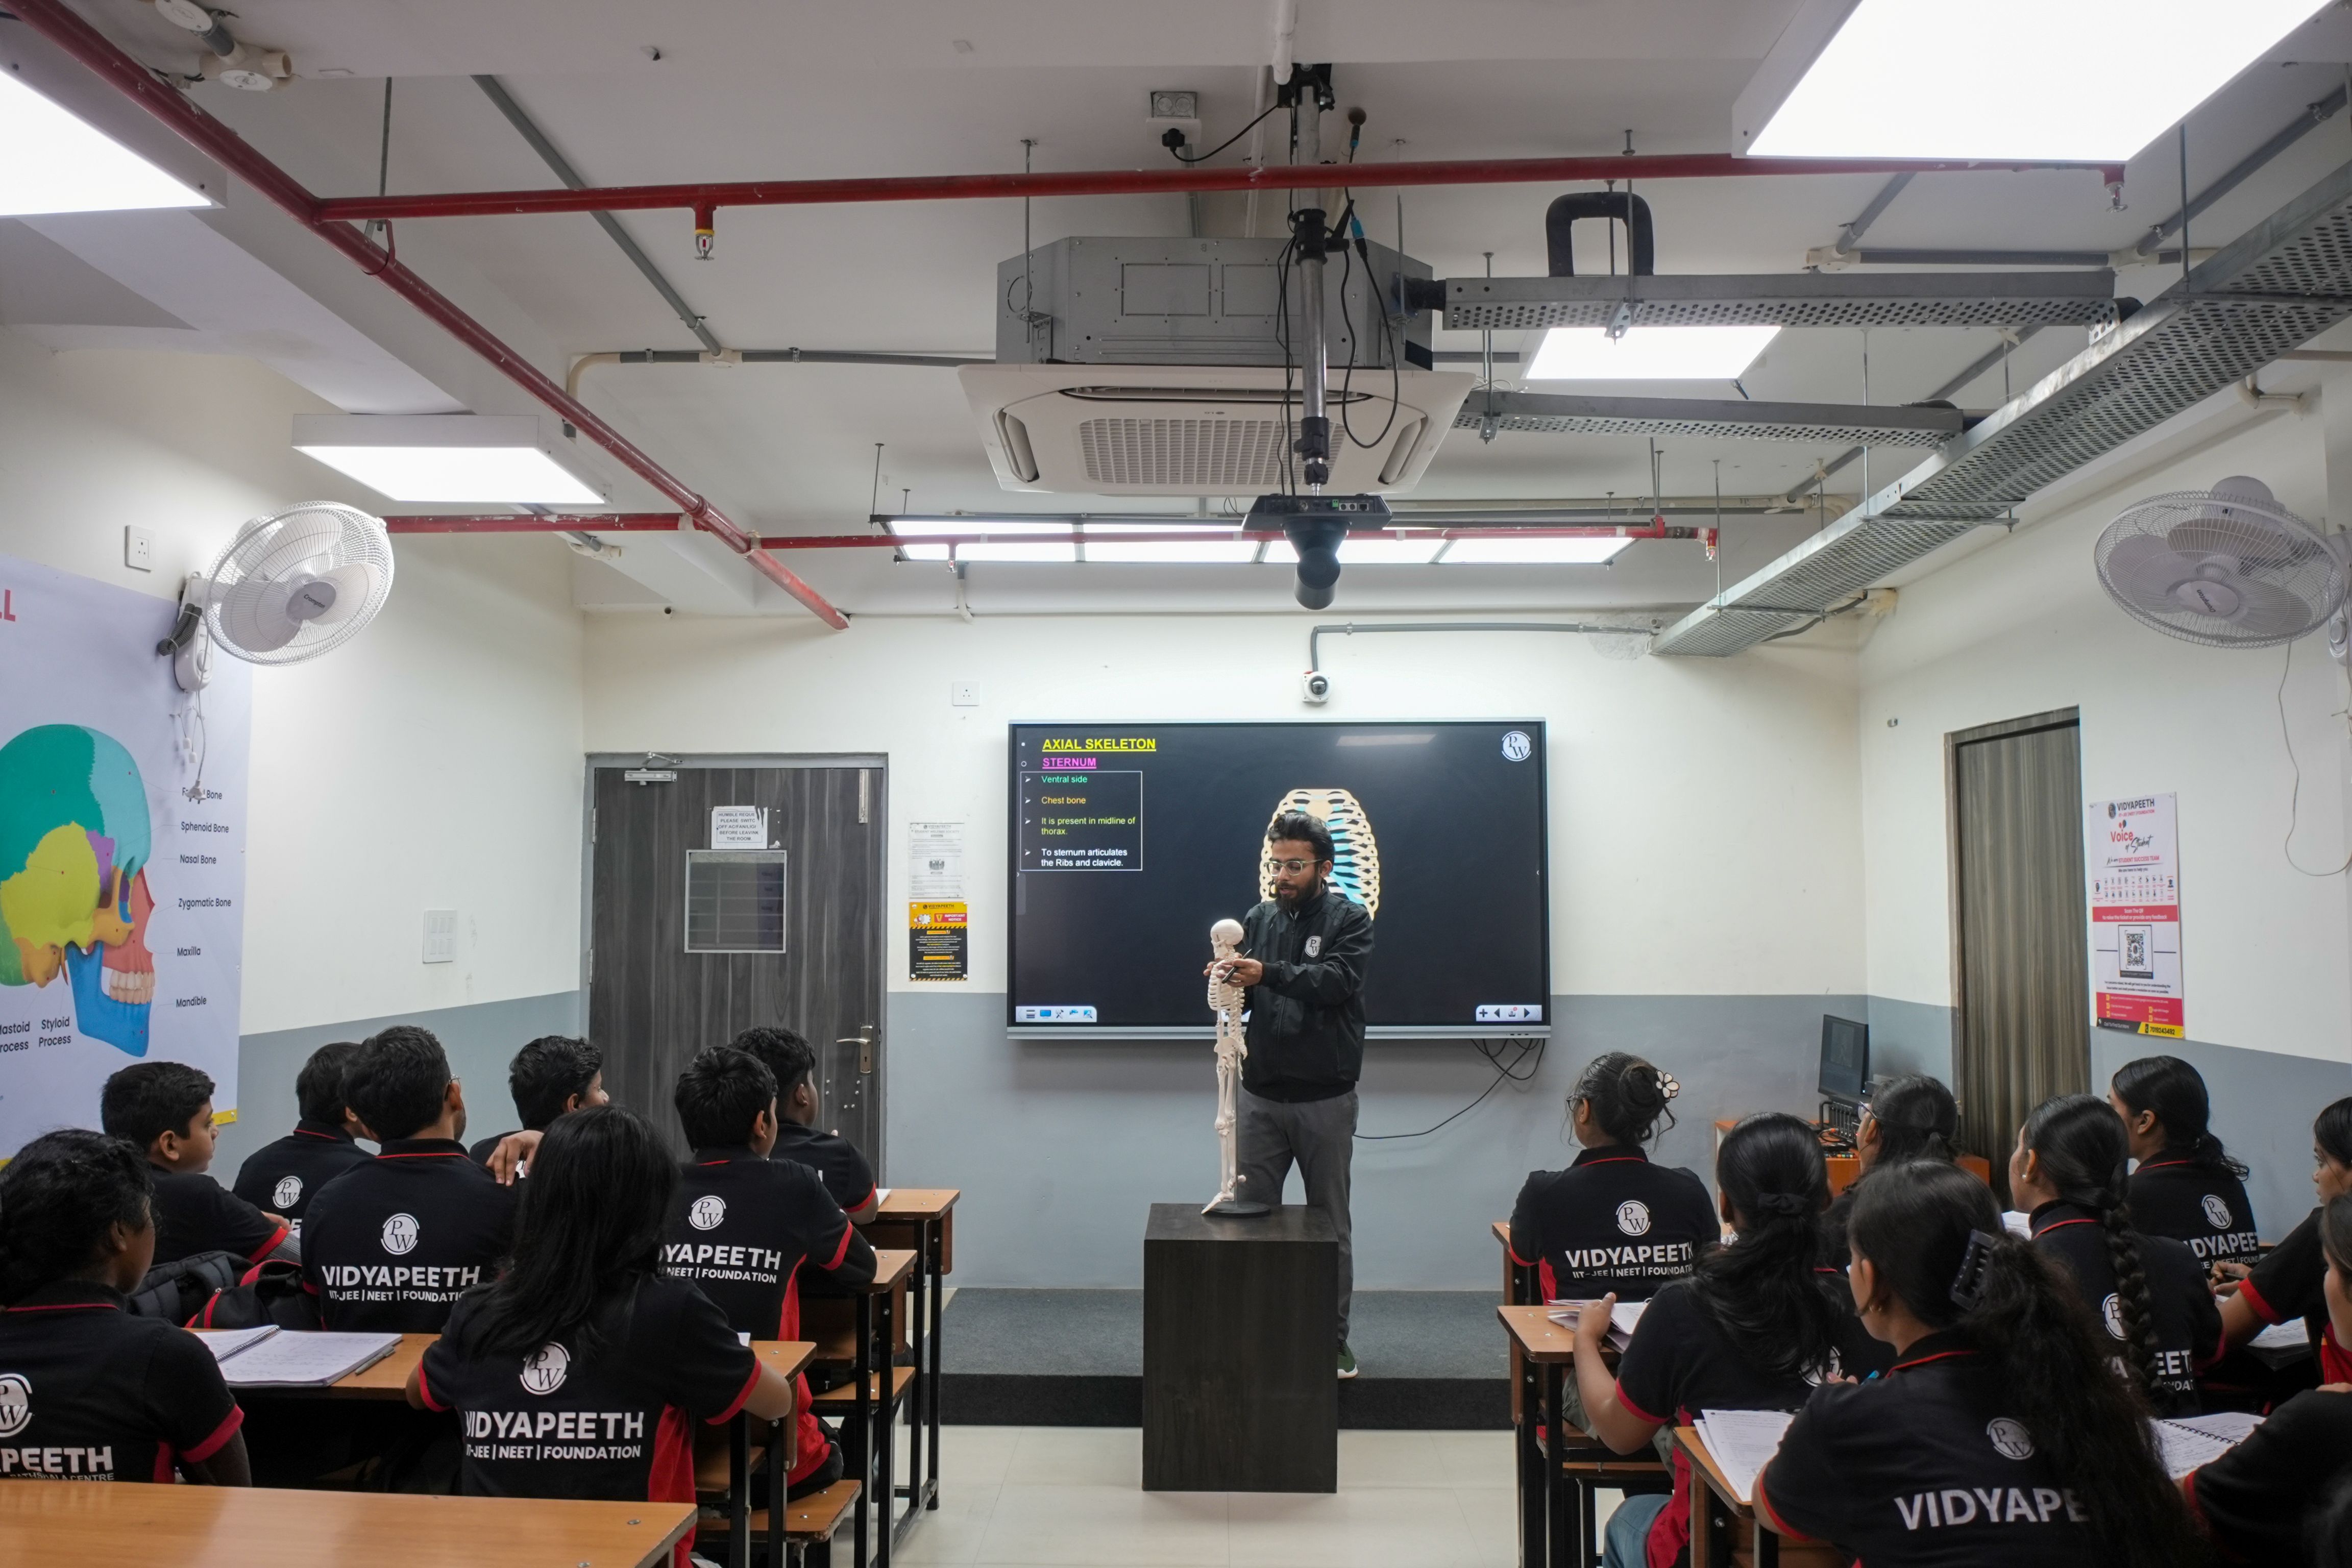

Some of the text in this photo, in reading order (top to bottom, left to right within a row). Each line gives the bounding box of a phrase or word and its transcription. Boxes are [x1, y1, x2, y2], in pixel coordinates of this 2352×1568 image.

[2197, 590, 2216, 612] Crompton
[1042, 738, 1156, 749] AXIAL SKELETON
[1042, 757, 1096, 767] STERNUM
[207, 790, 223, 799] Bone
[2117, 798, 2155, 811] VIDYAPEETH
[181, 821, 229, 834] Sphenoid Bone
[1057, 818, 1087, 826] present
[1128, 816, 1136, 824] of
[2111, 829, 2134, 842] Voice
[180, 854, 216, 864] Nasal Bone
[178, 897, 231, 910] Zygomatic Bone
[177, 946, 201, 957] Maxilla
[176, 996, 207, 1008] Mandible
[41, 1016, 69, 1032] Styloid
[0, 1041, 29, 1053] rocess
[39, 1035, 71, 1047] Process
[2183, 1232, 2257, 1258] DYAPEE
[658, 1244, 781, 1270] YAPEETH
[322, 1265, 481, 1287] VIDYAPEETH
[667, 1267, 694, 1277] NEET
[702, 1268, 777, 1284] FOUNDATION
[1572, 1270, 1608, 1278] IIT-JEE
[1616, 1267, 1640, 1277] NEET
[329, 1290, 359, 1301] IIT-JEE
[367, 1291, 394, 1301] NEET
[403, 1290, 464, 1302] FOUNDATI
[465, 1411, 644, 1439] VIDYAPEETH
[499, 1446, 533, 1458] NEET
[544, 1445, 641, 1459] FOUNDATION
[0, 1446, 113, 1473] PEETH
[1894, 1487, 2090, 1531] VIDYAPE
